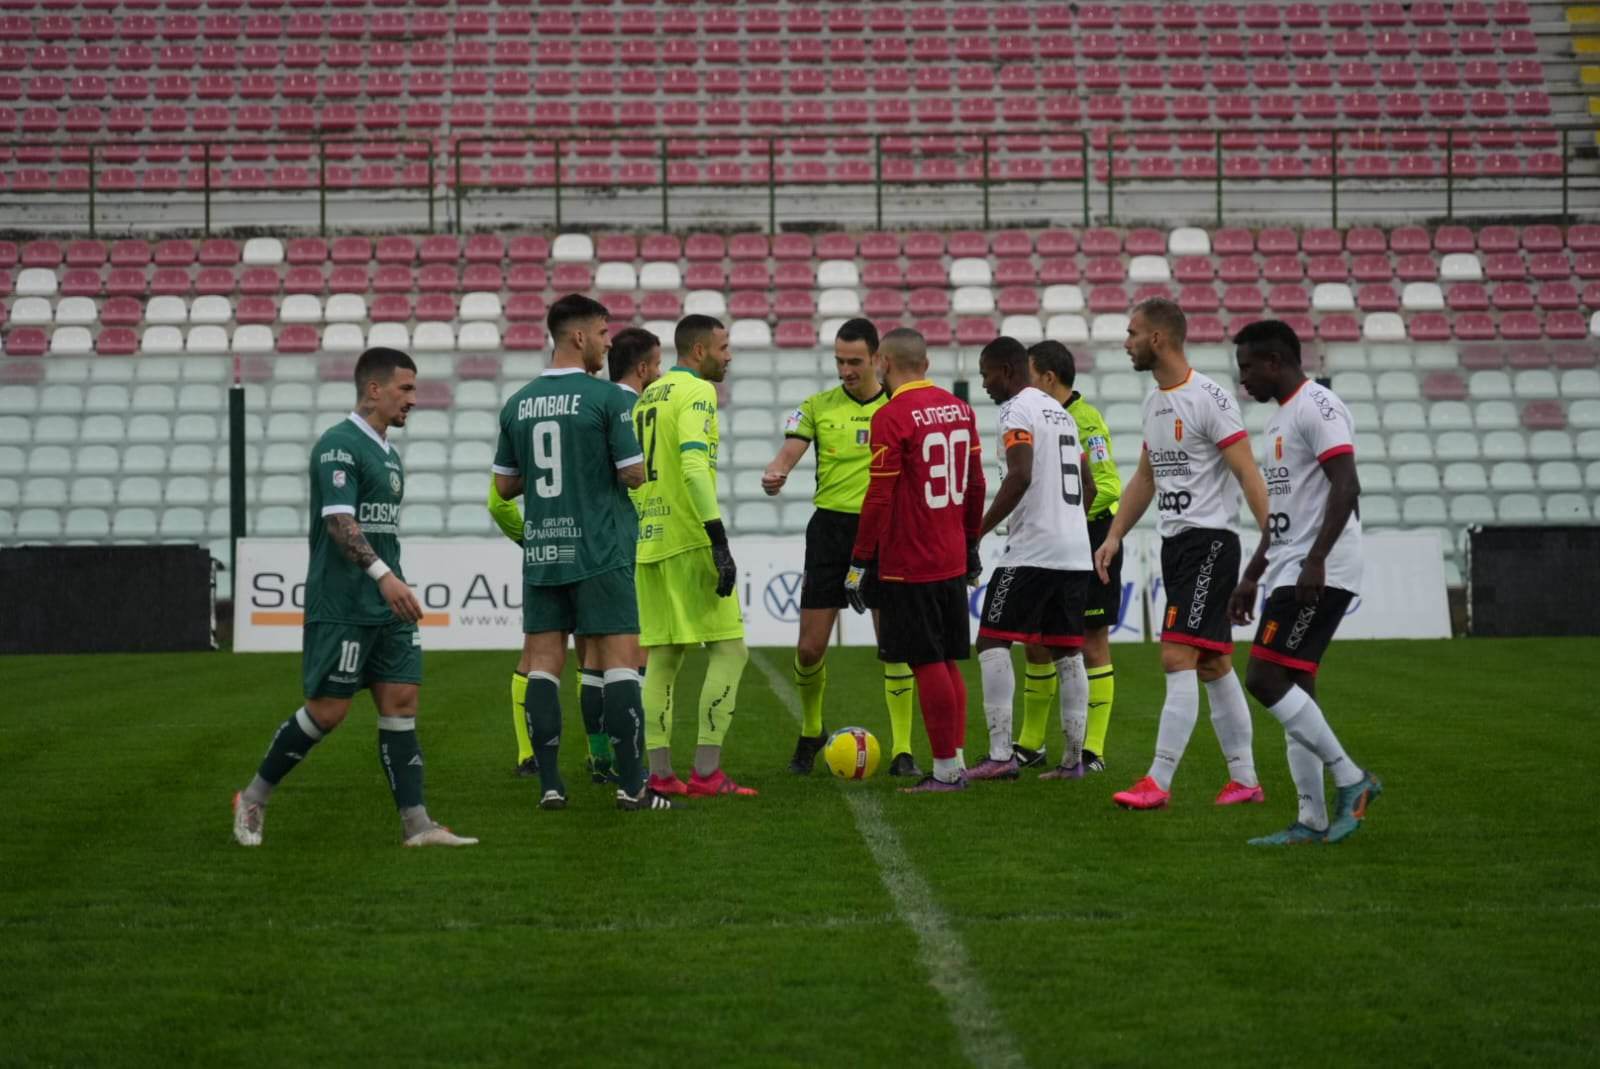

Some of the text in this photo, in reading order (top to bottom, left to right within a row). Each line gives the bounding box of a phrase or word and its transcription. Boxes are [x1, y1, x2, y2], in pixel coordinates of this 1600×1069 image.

[518, 394, 582, 421] GAMBALE
[532, 420, 563, 498] 9
[636, 407, 658, 481] 12
[922, 429, 971, 509] 30
[1059, 435, 1082, 506] 6
[525, 545, 558, 563] HUB
[338, 640, 361, 673] 10
